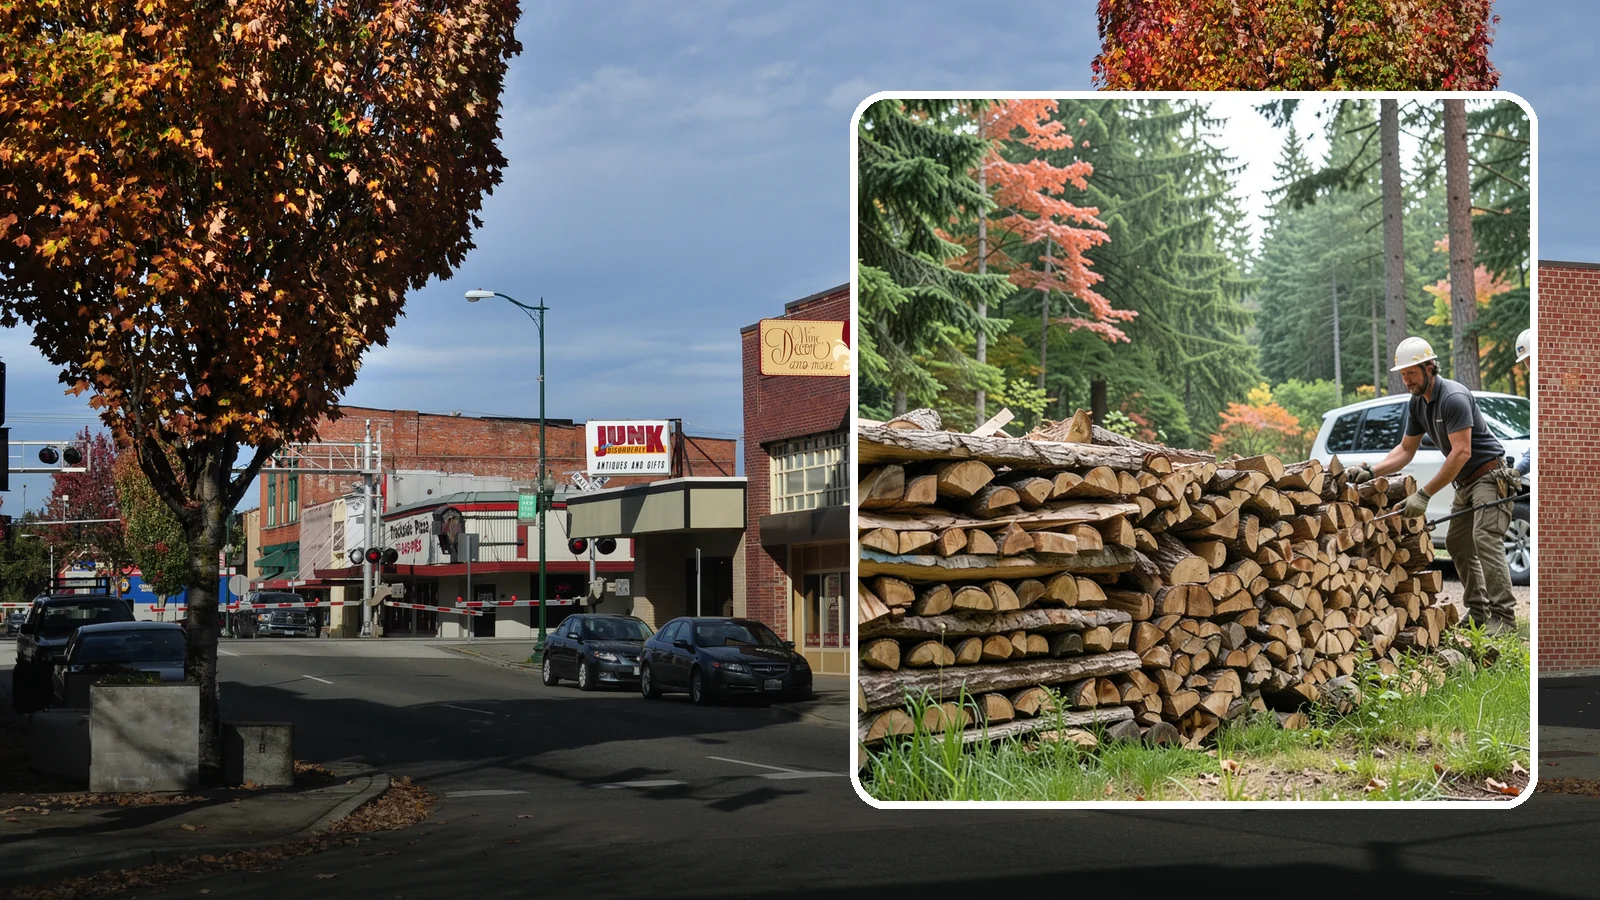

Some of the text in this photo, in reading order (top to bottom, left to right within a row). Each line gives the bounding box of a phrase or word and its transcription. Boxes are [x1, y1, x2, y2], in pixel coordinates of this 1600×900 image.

[595, 425, 665, 457] JUNK
[607, 446, 646, 454] DISORDERLY
[596, 460, 665, 470] ANTIQUES AND GIFTS
[414, 519, 429, 535] Pizza
